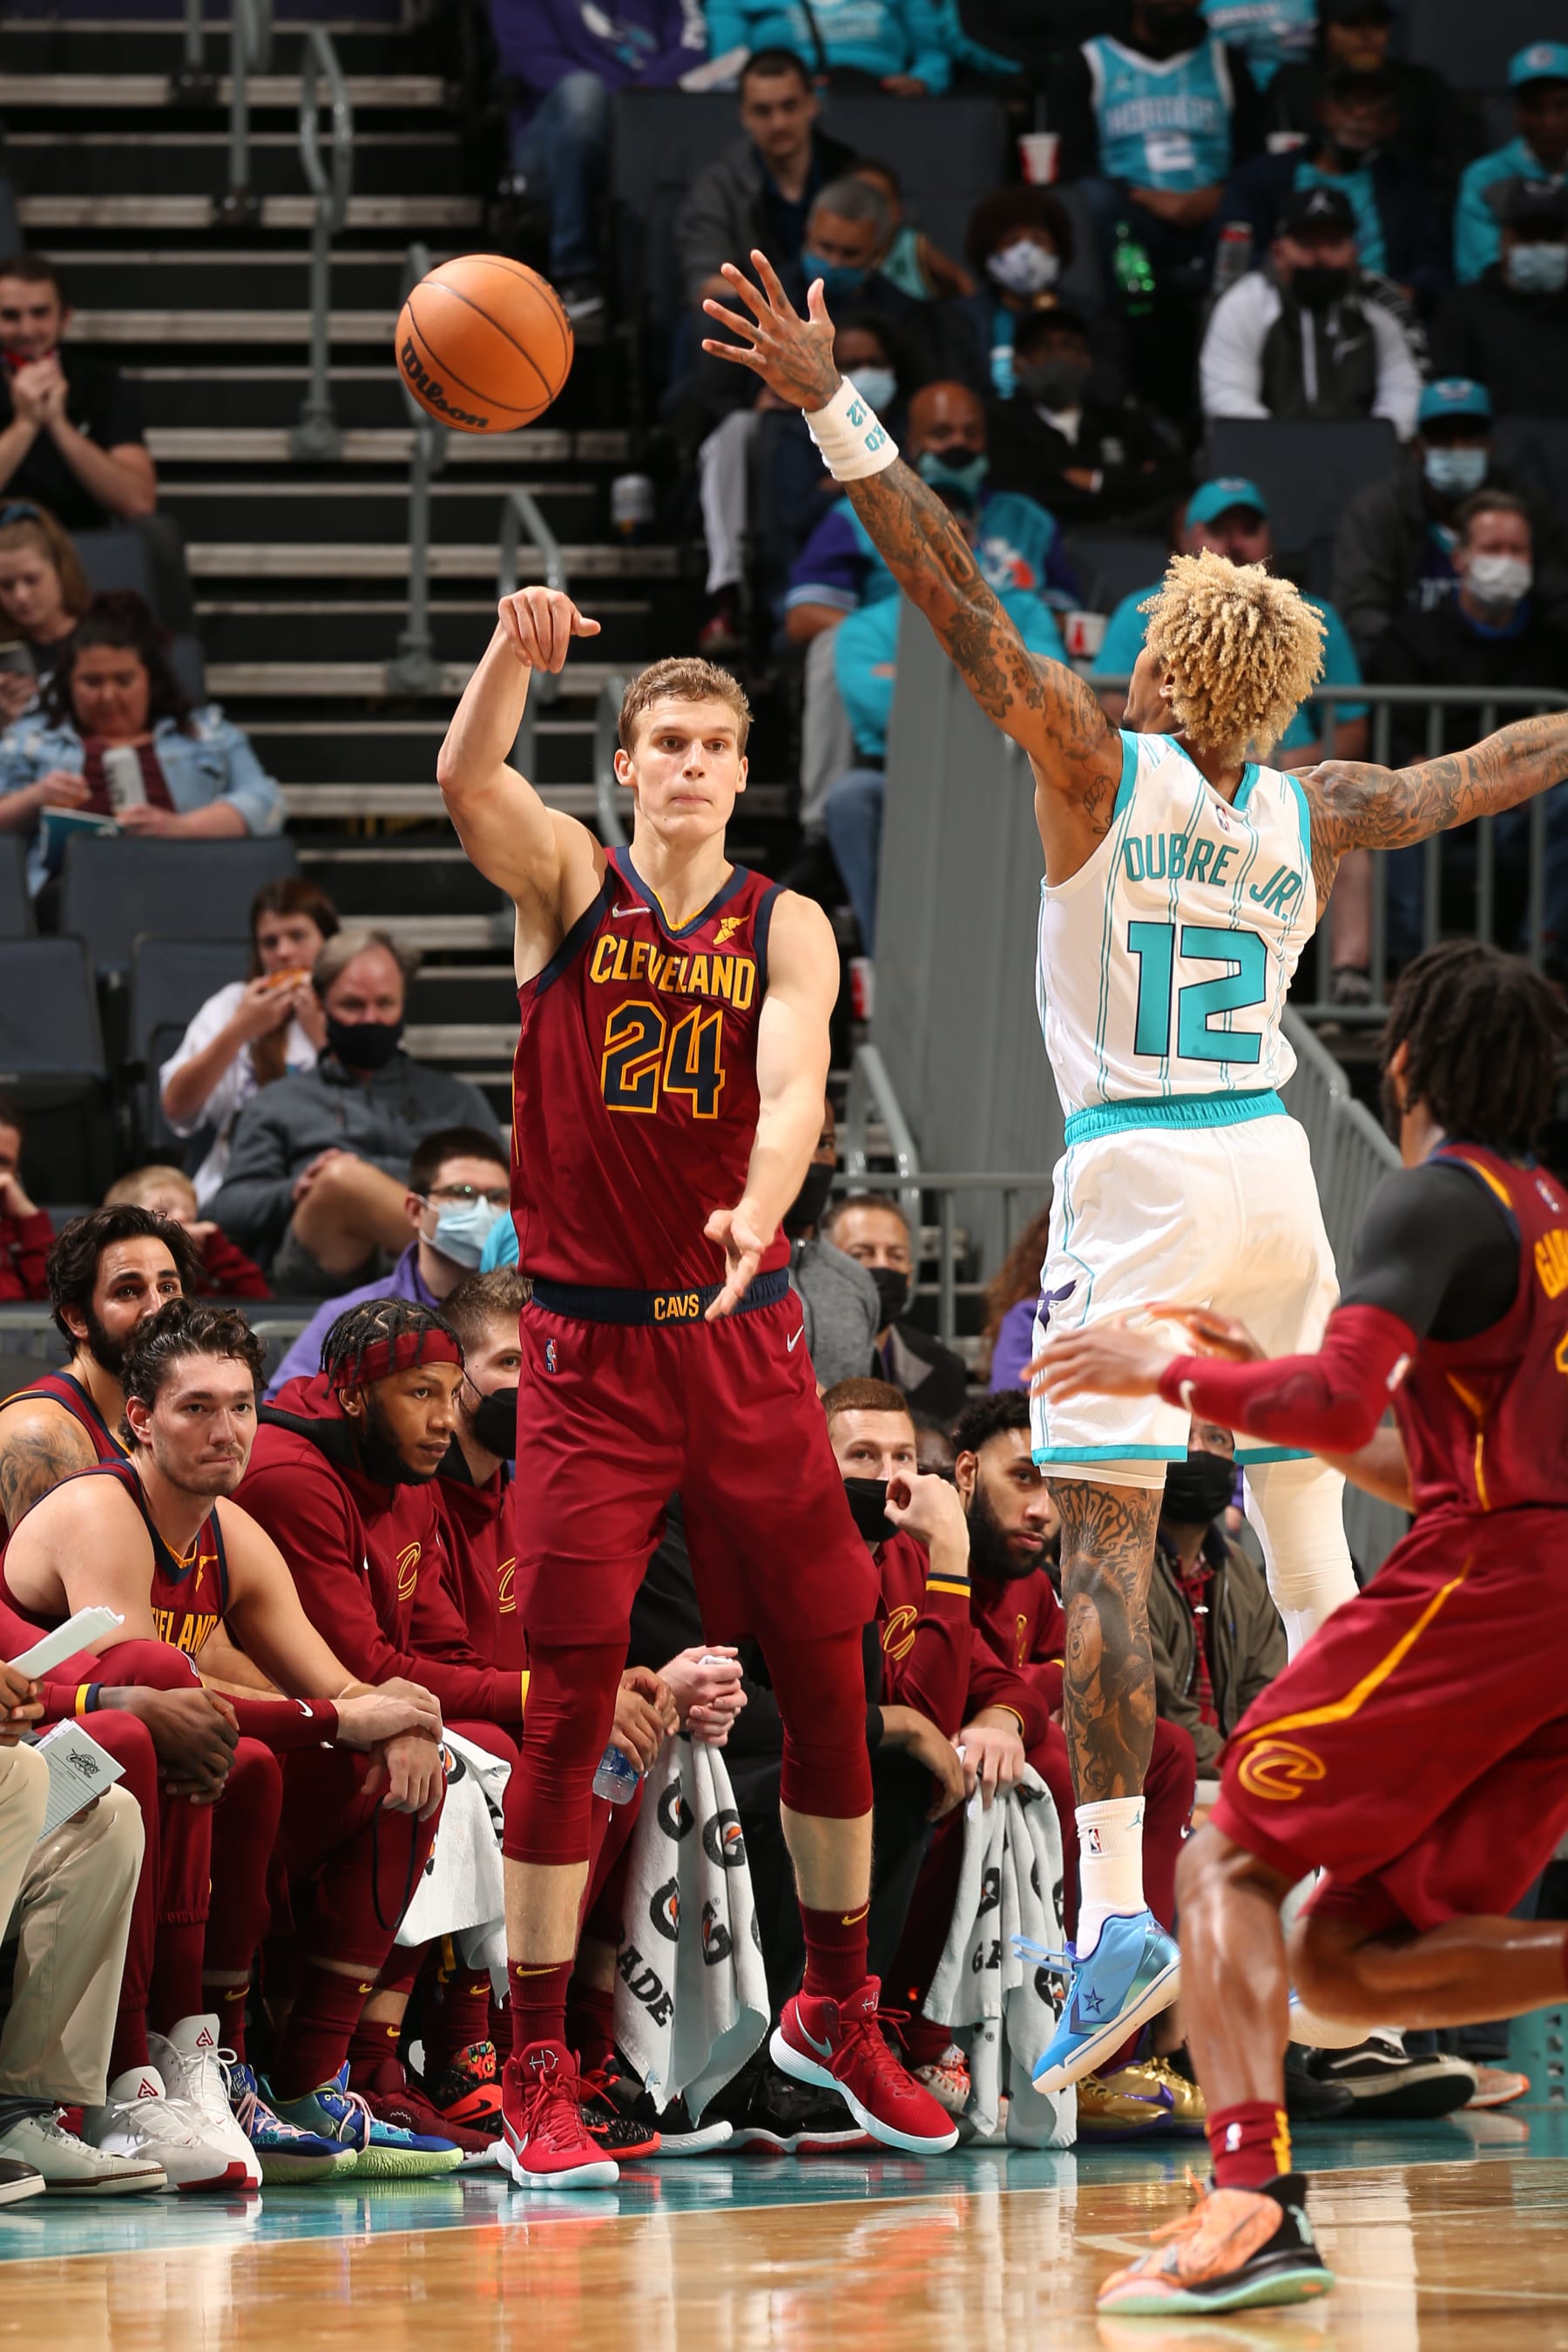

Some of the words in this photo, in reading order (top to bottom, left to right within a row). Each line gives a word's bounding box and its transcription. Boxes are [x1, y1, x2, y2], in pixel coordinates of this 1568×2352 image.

[401, 335, 489, 428] Wilson
[1123, 833, 1240, 887] OUBRE
[1249, 864, 1302, 921] JR.
[589, 933, 756, 1010] CLEVELAND
[1127, 920, 1268, 1064] 12
[600, 999, 726, 1119] 24
[654, 1294, 700, 1321] CAVS
[615, 1923, 675, 2028] ADE
